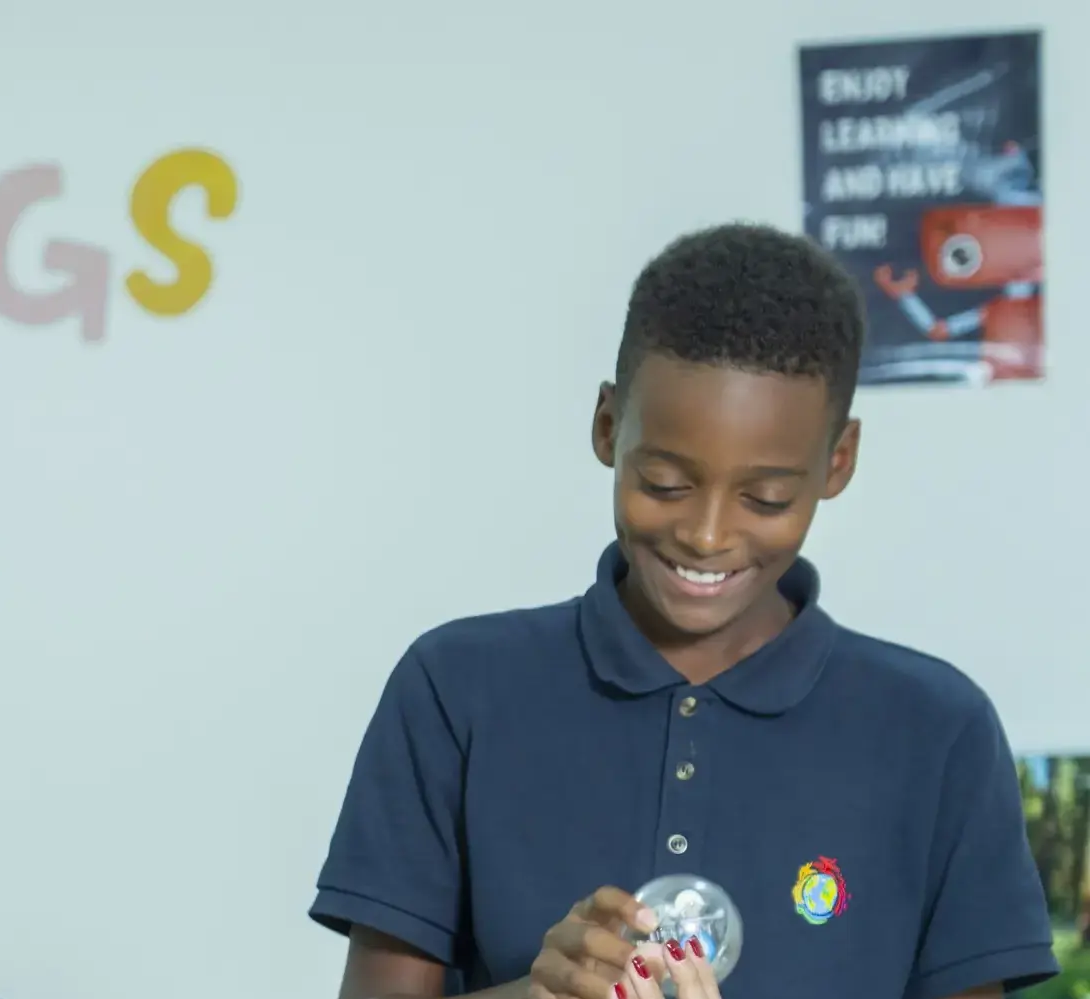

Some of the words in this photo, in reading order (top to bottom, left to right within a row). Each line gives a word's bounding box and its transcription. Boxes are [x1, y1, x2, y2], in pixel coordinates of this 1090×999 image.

[819, 66, 909, 104] ENJOY
[821, 164, 885, 200] AND
[886, 161, 963, 197] HAVE
